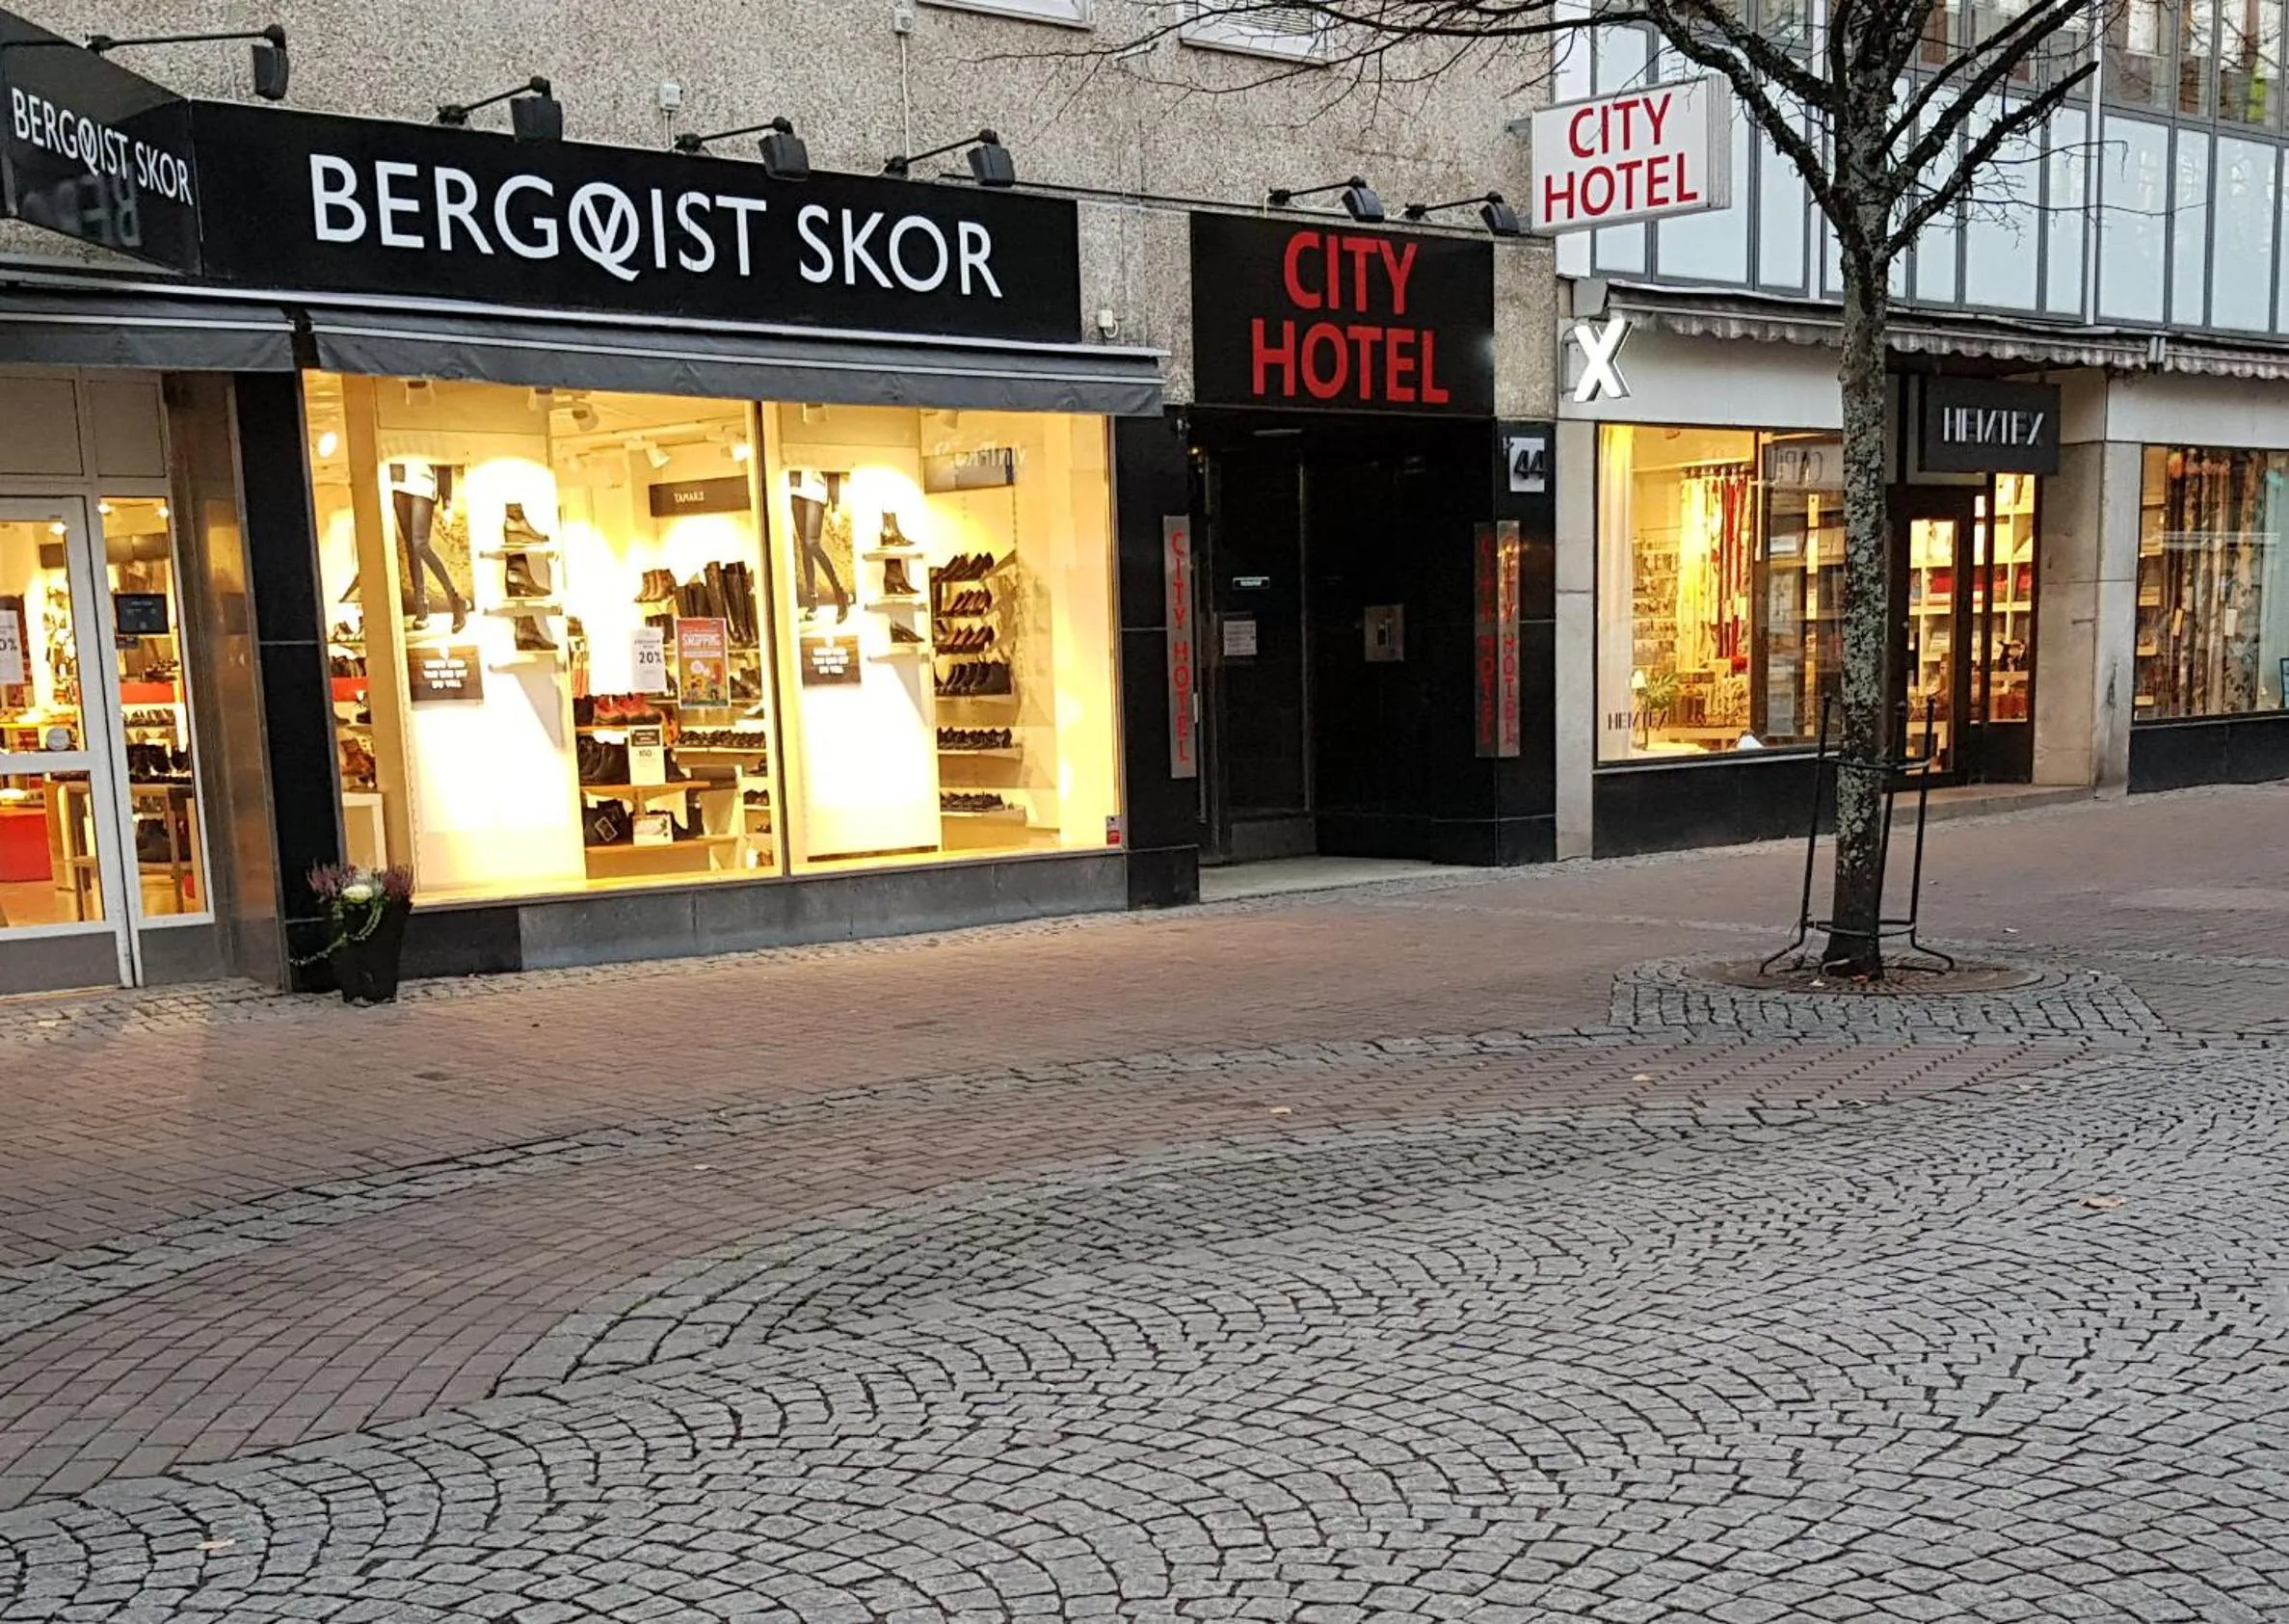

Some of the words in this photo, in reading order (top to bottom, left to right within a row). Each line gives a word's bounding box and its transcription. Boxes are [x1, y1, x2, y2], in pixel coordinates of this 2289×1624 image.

[1568, 93, 1672, 158] CITY
[135, 141, 194, 206] SKOR
[1544, 152, 1698, 224] HOTEL
[796, 203, 1003, 299] SKOR
[1283, 230, 1418, 315] CITY
[1251, 317, 1450, 404] HOTEL
[1513, 448, 1548, 480] 44
[1170, 529, 1187, 630] CITY
[638, 651, 662, 664] 20%
[1172, 640, 1190, 763] HOTEL
